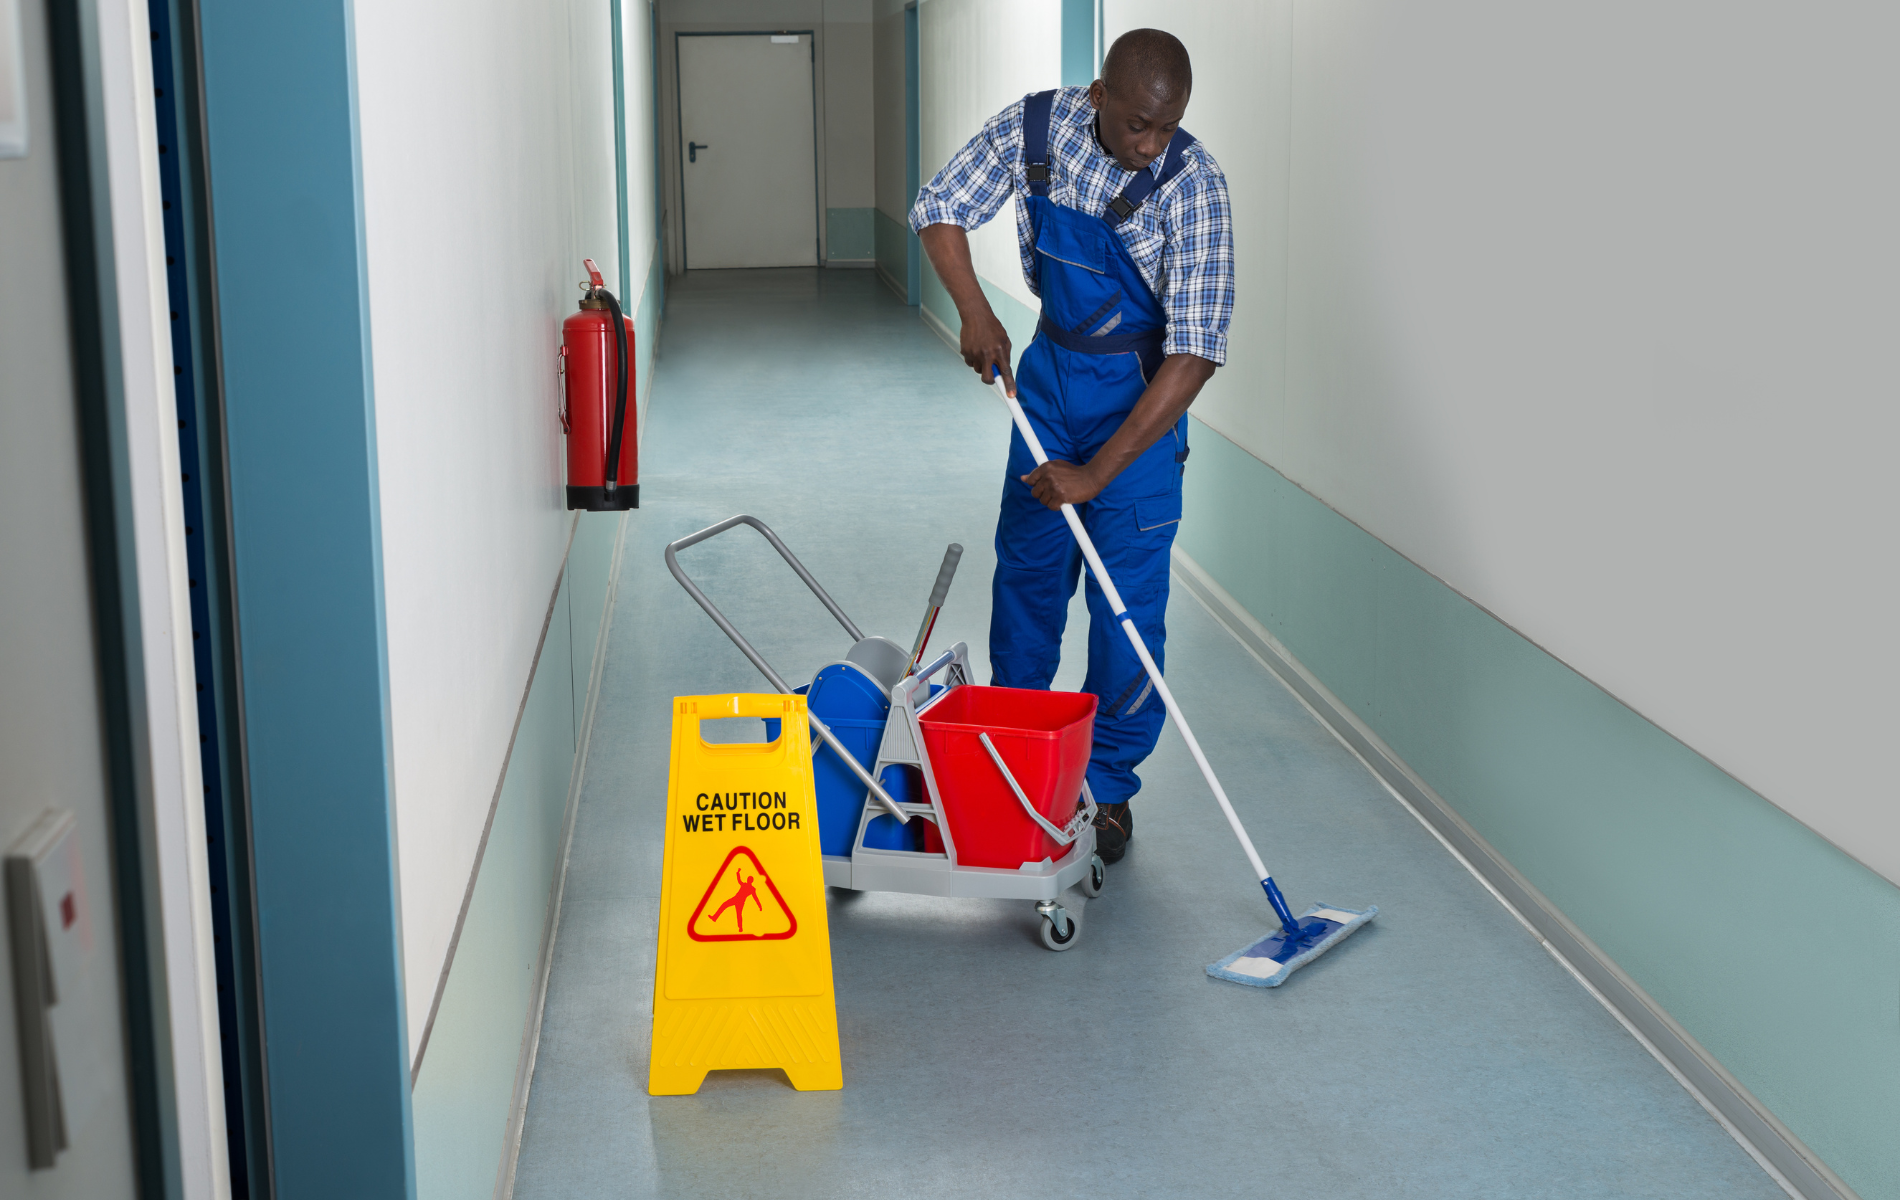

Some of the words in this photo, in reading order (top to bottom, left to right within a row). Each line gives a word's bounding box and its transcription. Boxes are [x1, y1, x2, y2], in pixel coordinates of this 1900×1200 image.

[696, 791, 787, 811] CAUTION
[683, 813, 726, 832] WET
[732, 812, 800, 831] FLOOR
